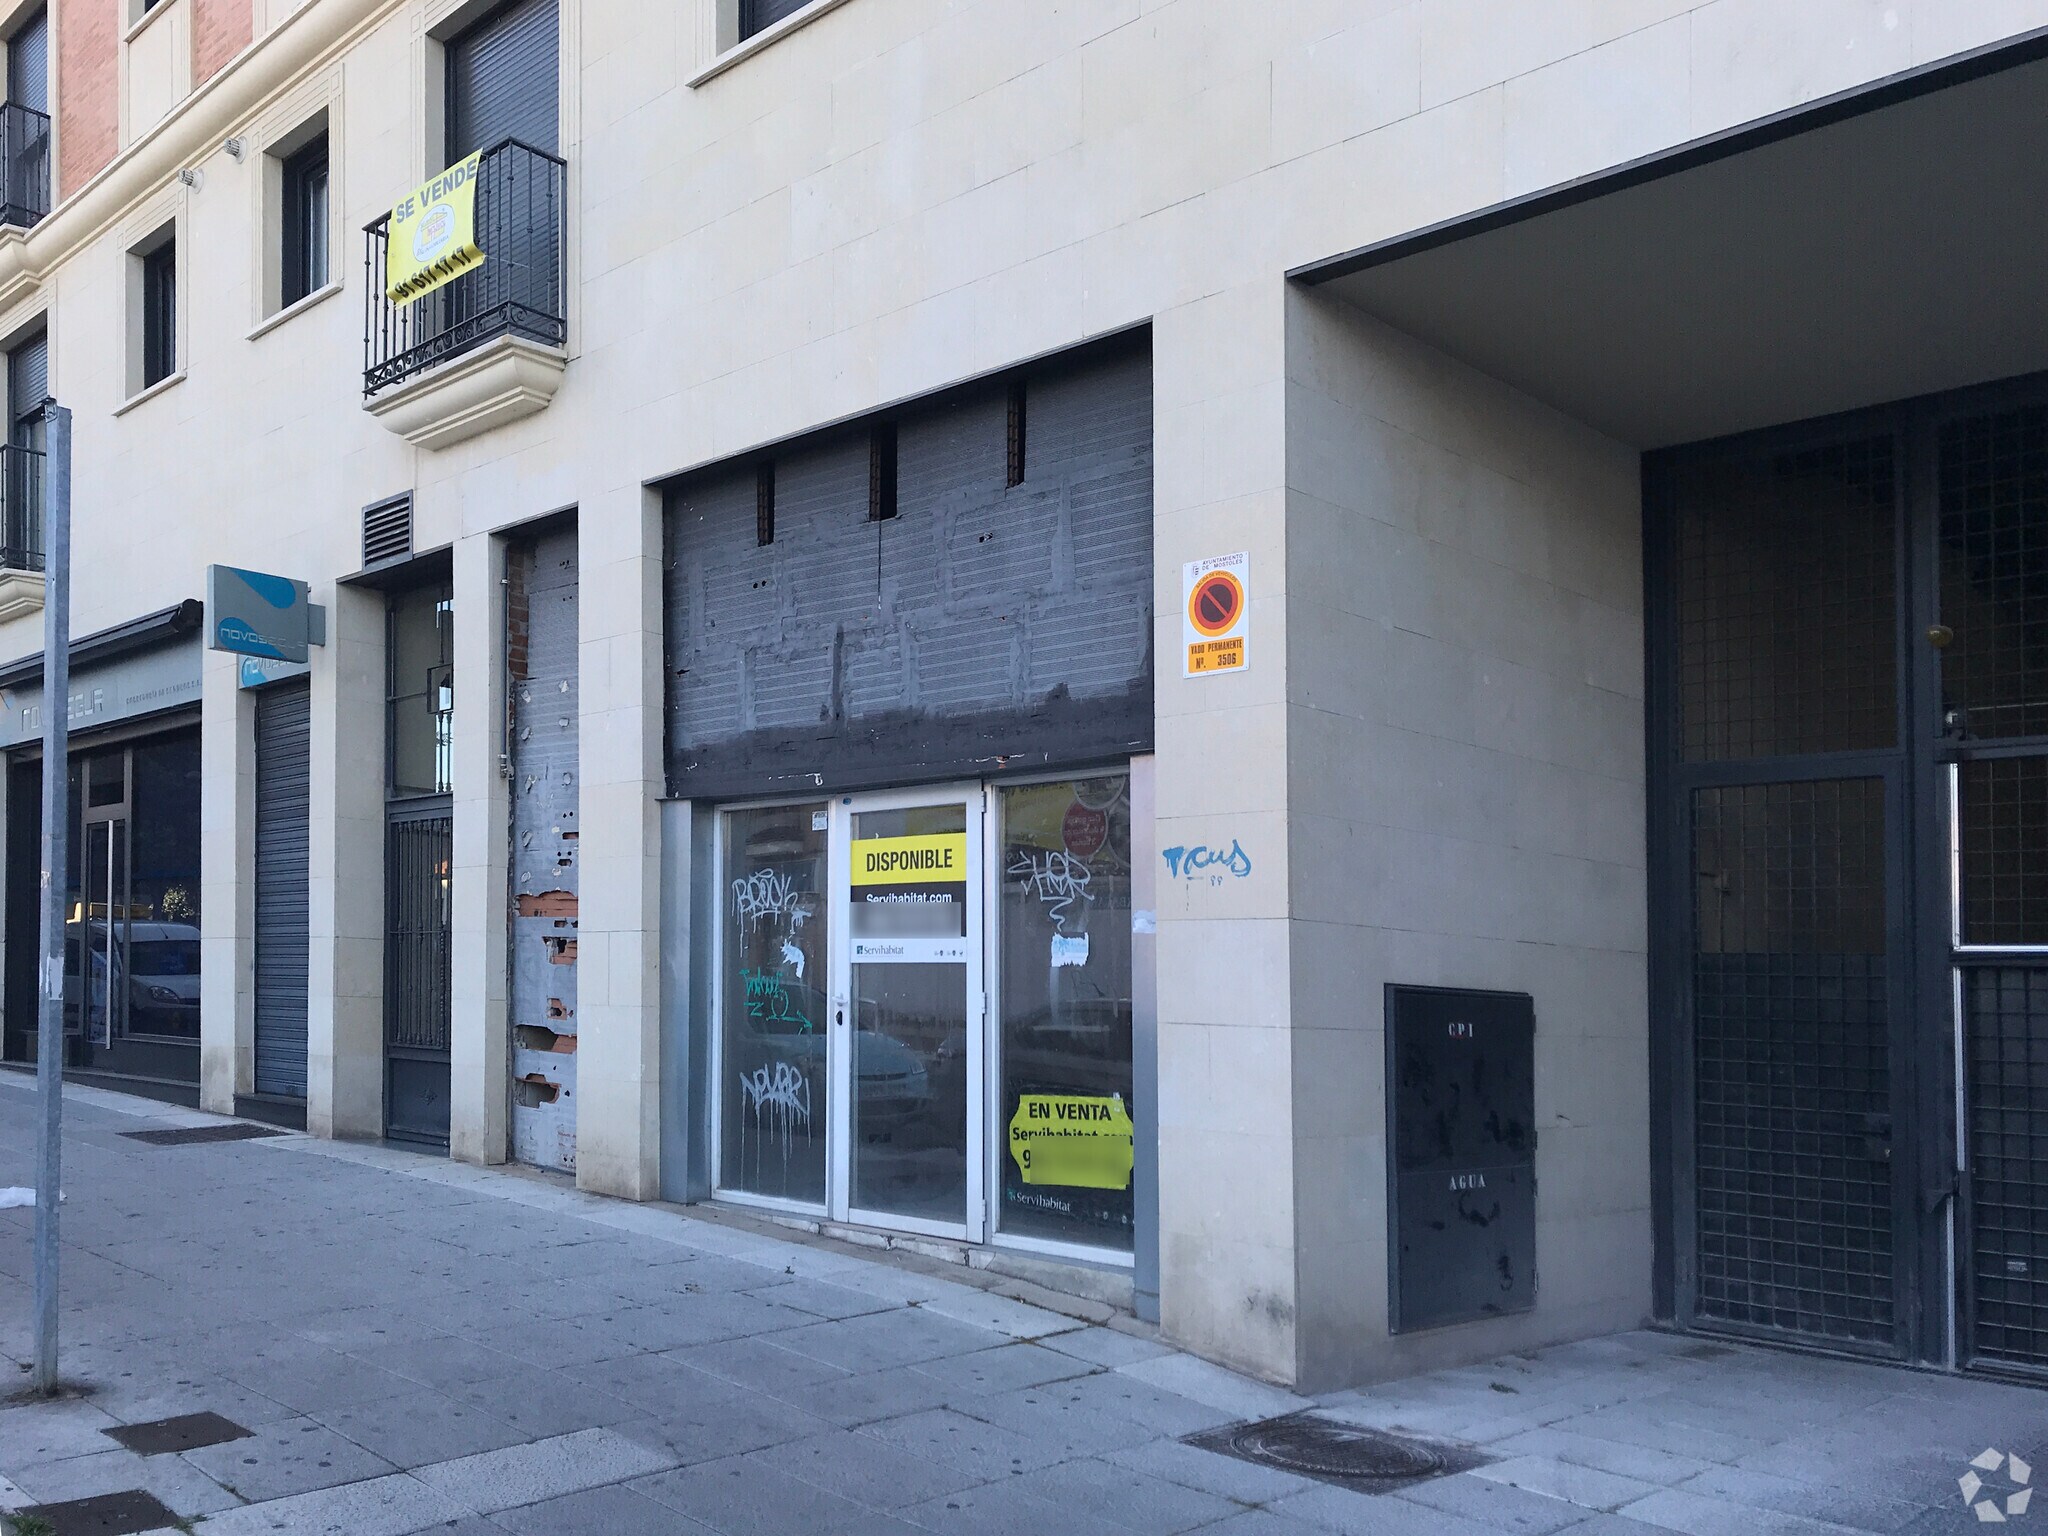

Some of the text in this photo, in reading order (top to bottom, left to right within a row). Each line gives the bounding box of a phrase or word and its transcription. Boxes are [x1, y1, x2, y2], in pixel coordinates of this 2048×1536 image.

[396, 158, 477, 224] SE VENDE
[1202, 553, 1244, 566] AYUNTAMIENTO
[1190, 638, 1242, 655] VADO PERMANENTE
[1217, 652, 1237, 666] 3506
[866, 848, 953, 872] DISPONIBLE
[863, 945, 904, 955] Servihabitat
[1028, 1102, 1112, 1121] EN VENTA
[1449, 1174, 1487, 1191] AGUA
[1016, 1192, 1071, 1213] Servihabitat
